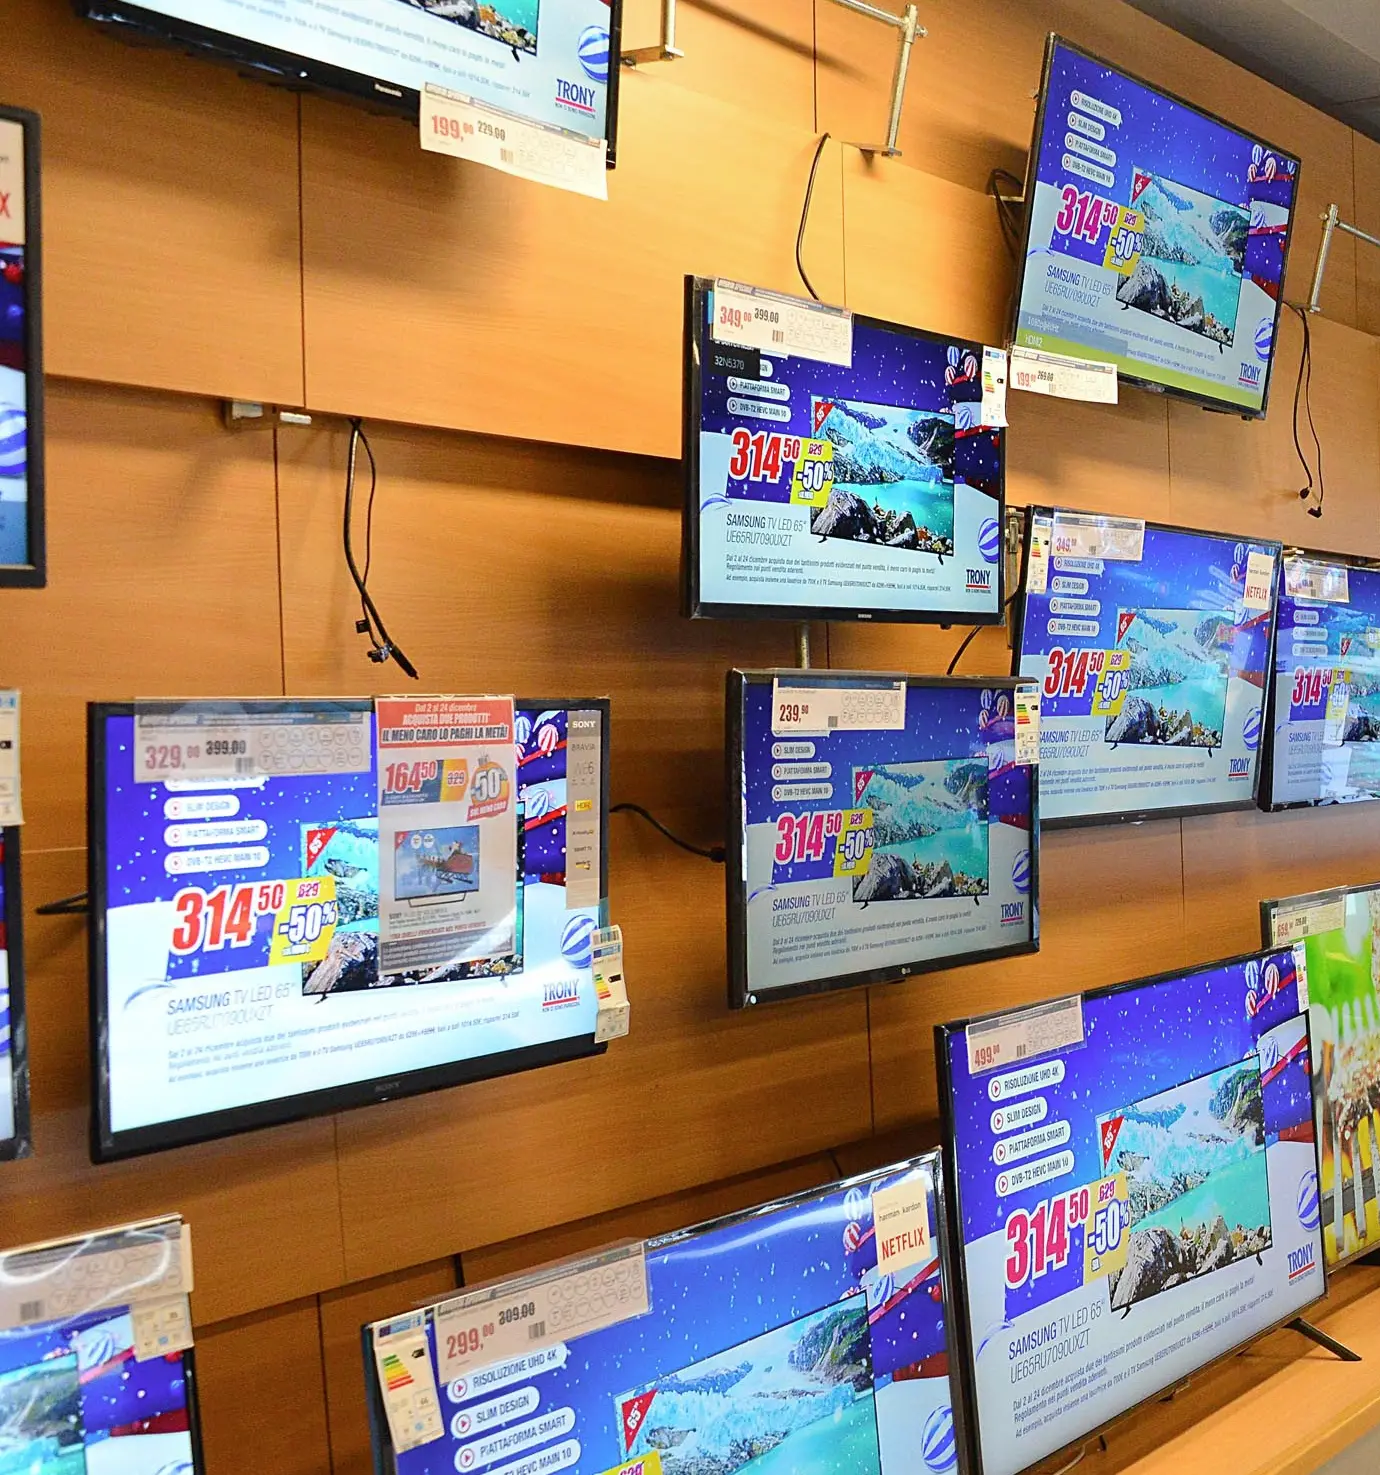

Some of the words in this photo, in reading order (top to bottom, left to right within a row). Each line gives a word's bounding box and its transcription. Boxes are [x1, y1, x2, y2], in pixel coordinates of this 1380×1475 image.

[556, 78, 596, 108] TRONY
[1056, 187, 1103, 242] 314
[1110, 227, 1144, 260] -50%
[1046, 264, 1081, 286] SAMSUNG
[1240, 362, 1261, 381] TRONY
[729, 430, 782, 480] 314
[796, 460, 834, 491] -50%
[726, 513, 766, 529] SAMSUNG
[767, 517, 777, 529] TV
[778, 518, 793, 531] LED
[965, 568, 991, 585] TRONY
[1246, 585, 1267, 601] NETFLIX
[1044, 650, 1090, 695] 314
[1292, 668, 1321, 703] 314
[382, 729, 392, 742] IL
[392, 728, 415, 742] MENO
[416, 727, 439, 741] CARO
[440, 728, 449, 740] LO
[450, 727, 474, 740] PAGHI
[475, 726, 485, 739] LA
[572, 720, 595, 728] SONY
[1229, 758, 1251, 773] TRONY
[775, 815, 824, 861] 314
[838, 827, 875, 861] -50%
[772, 895, 811, 911] SAMSUNG
[811, 894, 821, 906] TV
[822, 892, 835, 905] LED
[1000, 901, 1024, 919] TRONY
[172, 887, 254, 950] 314
[278, 900, 337, 943] -50%
[167, 991, 230, 1016] SAMSUNG
[542, 978, 580, 1002] TRONY
[1004, 1070, 1039, 1090] RISOLUZIONE
[1039, 1068, 1051, 1081] UHD
[1051, 1065, 1060, 1077] 4K
[1006, 1109, 1020, 1123] SLIM
[1021, 1103, 1042, 1120] DESIGN
[1009, 1133, 1047, 1154] PIATTAFORMA
[1046, 1127, 1065, 1140] SMART
[1011, 1170, 1032, 1186] DVB-T2
[1032, 1164, 1047, 1180] HEVC
[1047, 1160, 1061, 1175] MAIN
[1062, 1156, 1069, 1168] 10
[878, 1209, 901, 1222] harman
[902, 1201, 922, 1213] kardon
[1006, 1198, 1068, 1284] 314
[1098, 1179, 1116, 1203] 629
[1088, 1199, 1130, 1255] -50%
[881, 1226, 926, 1261] NETFLIX
[1287, 1241, 1314, 1274] TRONY
[1009, 1321, 1057, 1360] SAMSUNG
[1058, 1314, 1071, 1336] TV
[1072, 1307, 1088, 1330] LED
[473, 1358, 527, 1389] RISOLUZIONE
[528, 1353, 546, 1370] UHD
[546, 1349, 558, 1361] 4K
[1010, 1328, 1091, 1384] UE65RU7090UXZT
[1041, 1380, 1065, 1397] dicembre
[476, 1407, 498, 1424] SLIM
[499, 1394, 530, 1415] DESIGN
[480, 1429, 538, 1457] PIATTAFORMA
[538, 1415, 567, 1433] SMART
[516, 1457, 539, 1475] HEVC
[538, 1450, 561, 1472] MAIN
[561, 1446, 572, 1459] 10
